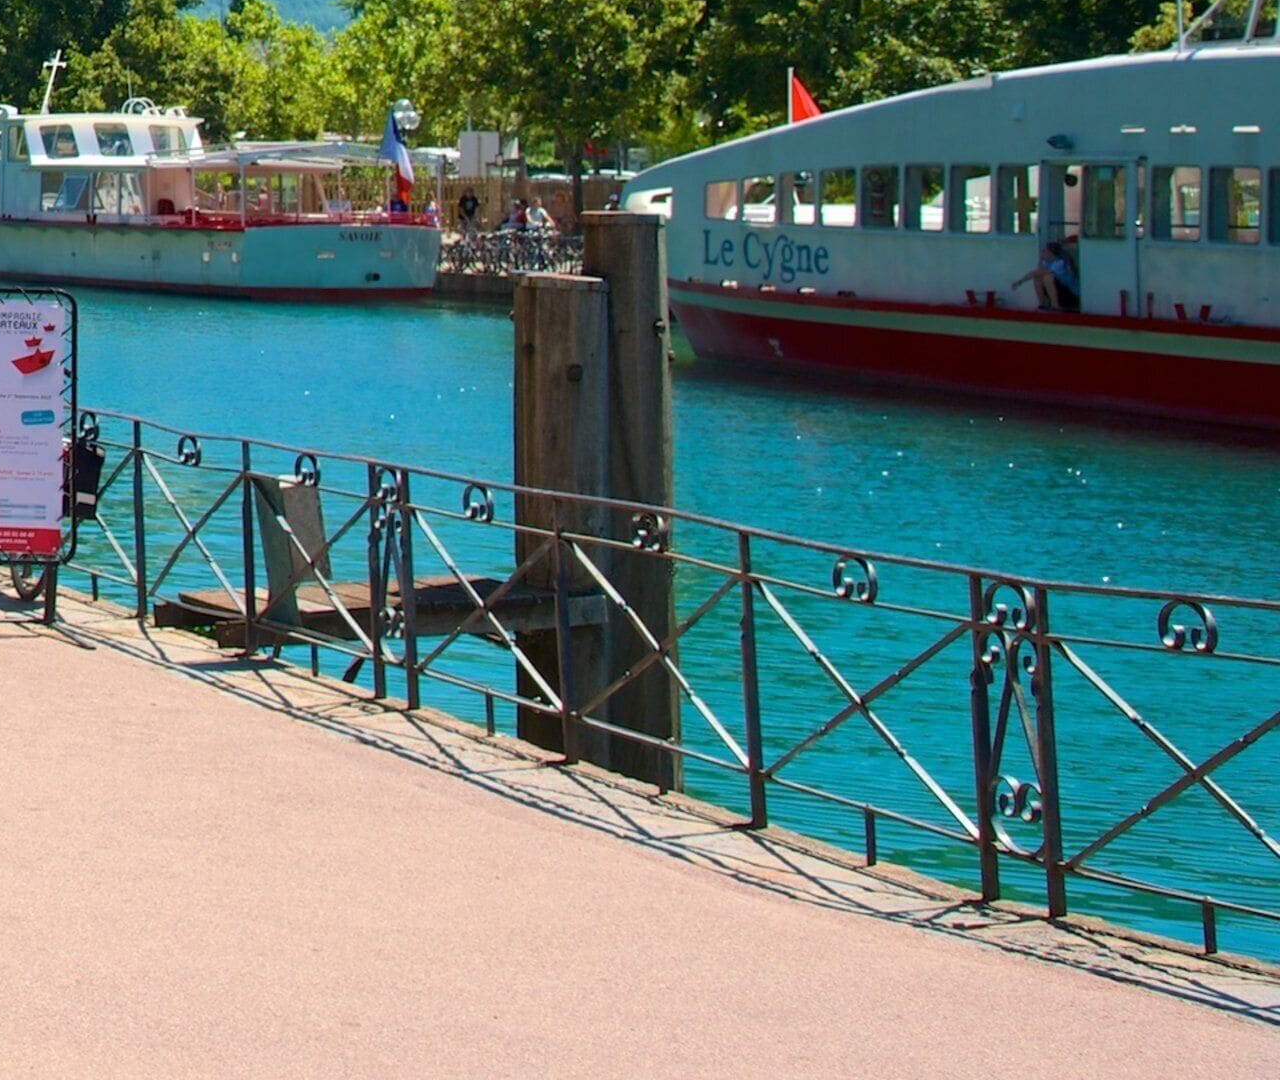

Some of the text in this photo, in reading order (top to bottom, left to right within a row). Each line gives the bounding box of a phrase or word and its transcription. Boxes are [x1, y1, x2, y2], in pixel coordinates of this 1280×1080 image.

[339, 230, 383, 242] SAVOIE
[703, 229, 830, 283] Le Cygne
